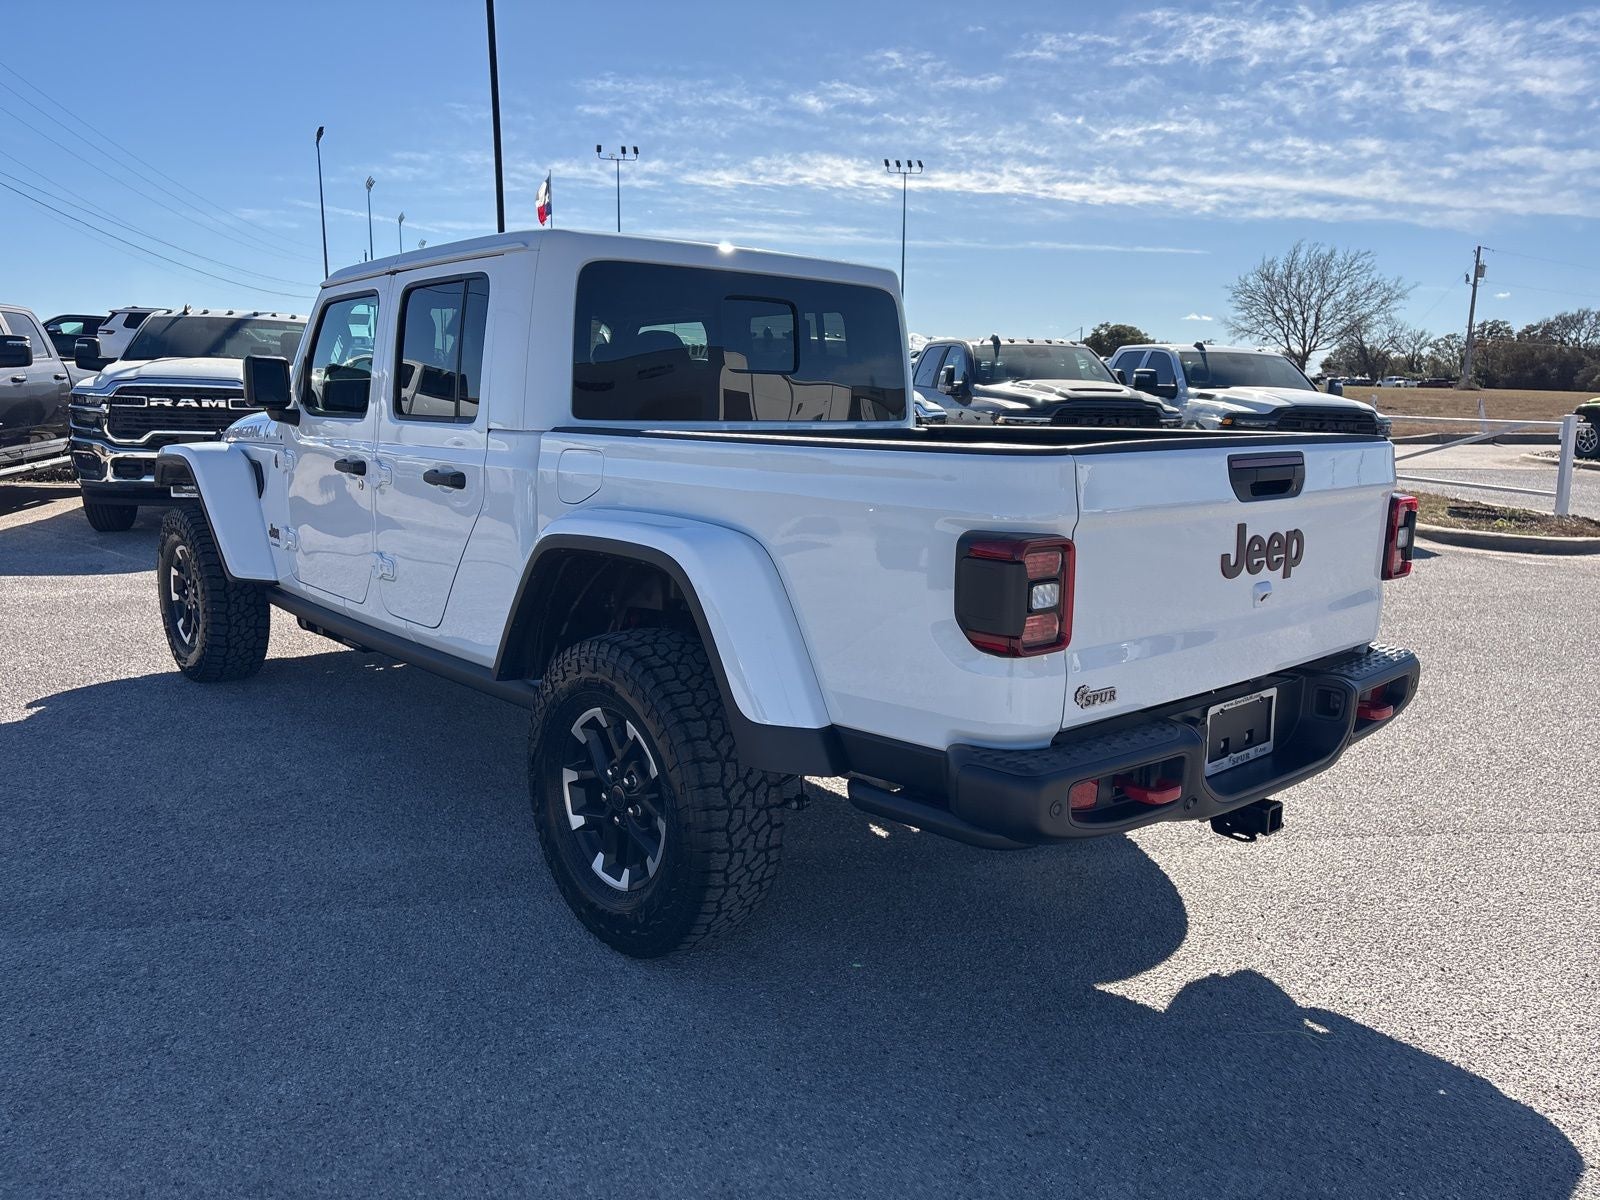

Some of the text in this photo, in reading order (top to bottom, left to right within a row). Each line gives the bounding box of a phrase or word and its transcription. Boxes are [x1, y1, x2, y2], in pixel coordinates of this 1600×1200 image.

[149, 397, 227, 408] RAM
[1220, 522, 1305, 580] Jeep
[1084, 690, 1116, 707] SPUR
